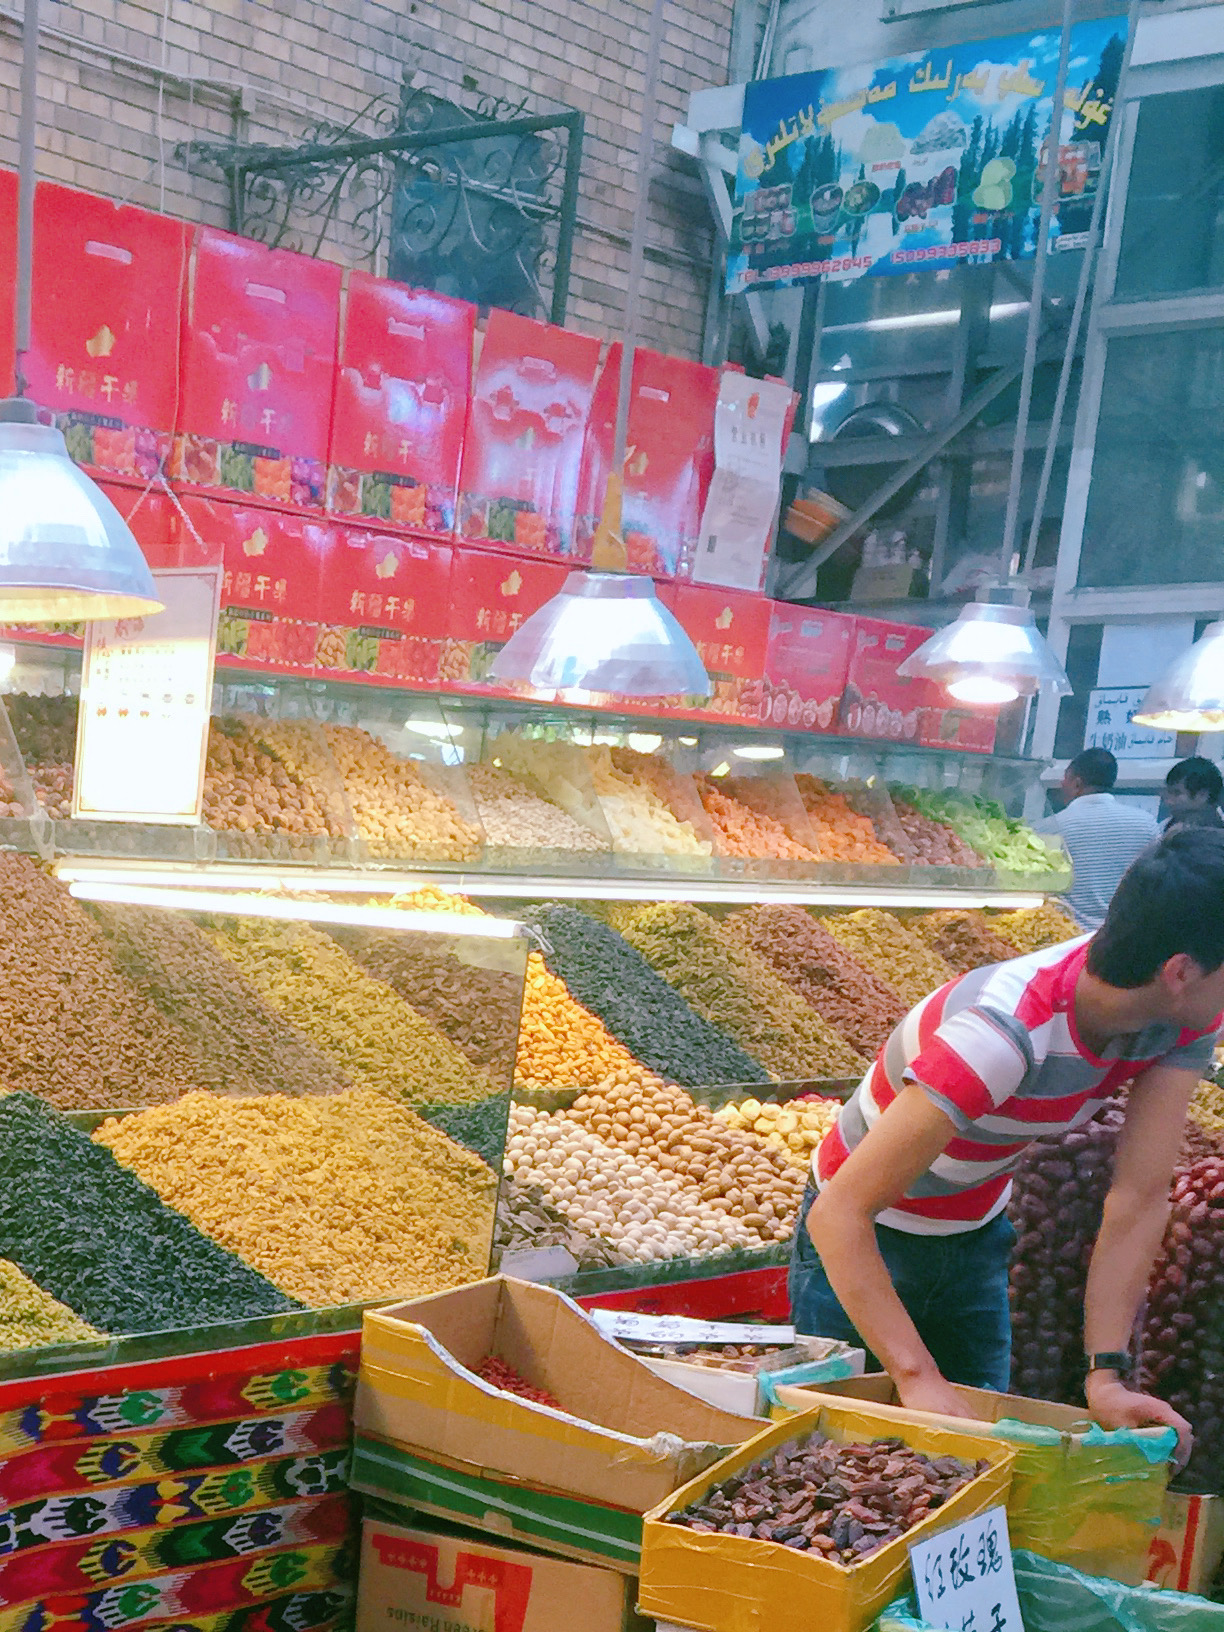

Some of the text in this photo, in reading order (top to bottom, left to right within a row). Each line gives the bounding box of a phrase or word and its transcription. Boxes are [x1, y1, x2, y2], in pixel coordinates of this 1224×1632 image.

[55, 363, 138, 405] 新疆干果
[349, 590, 415, 622] 新疆干果
[475, 607, 524, 633] 新疆干
